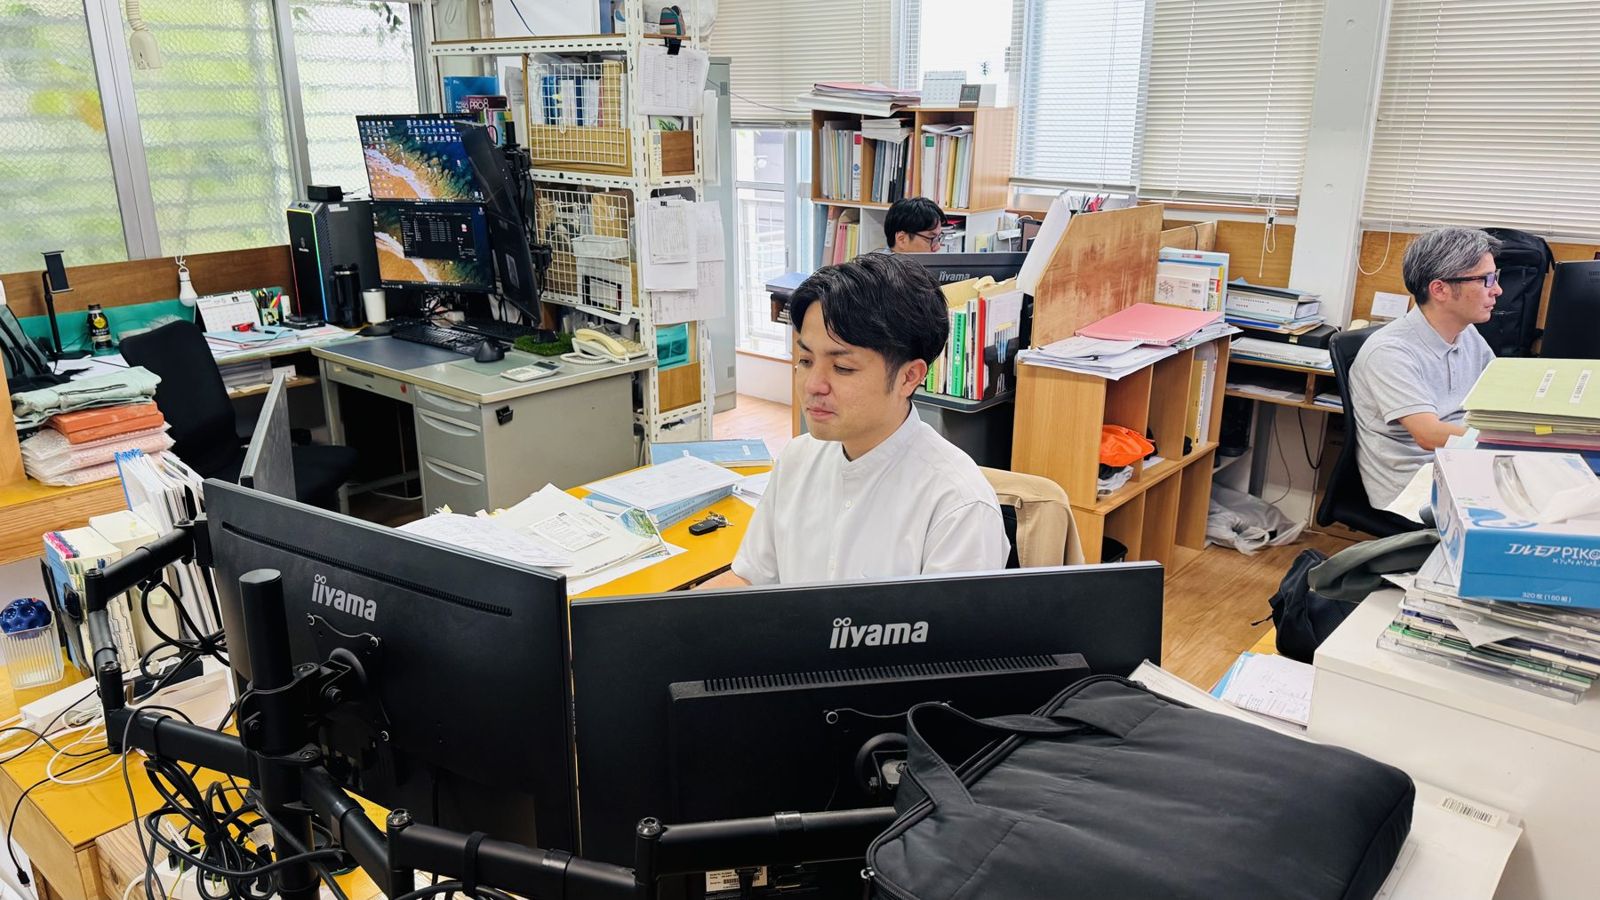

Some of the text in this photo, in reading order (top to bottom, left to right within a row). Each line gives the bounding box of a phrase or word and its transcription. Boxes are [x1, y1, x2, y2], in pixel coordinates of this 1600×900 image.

[939, 270, 971, 282] iiyama
[311, 573, 378, 622] iiyama
[829, 616, 929, 649] iiyama
